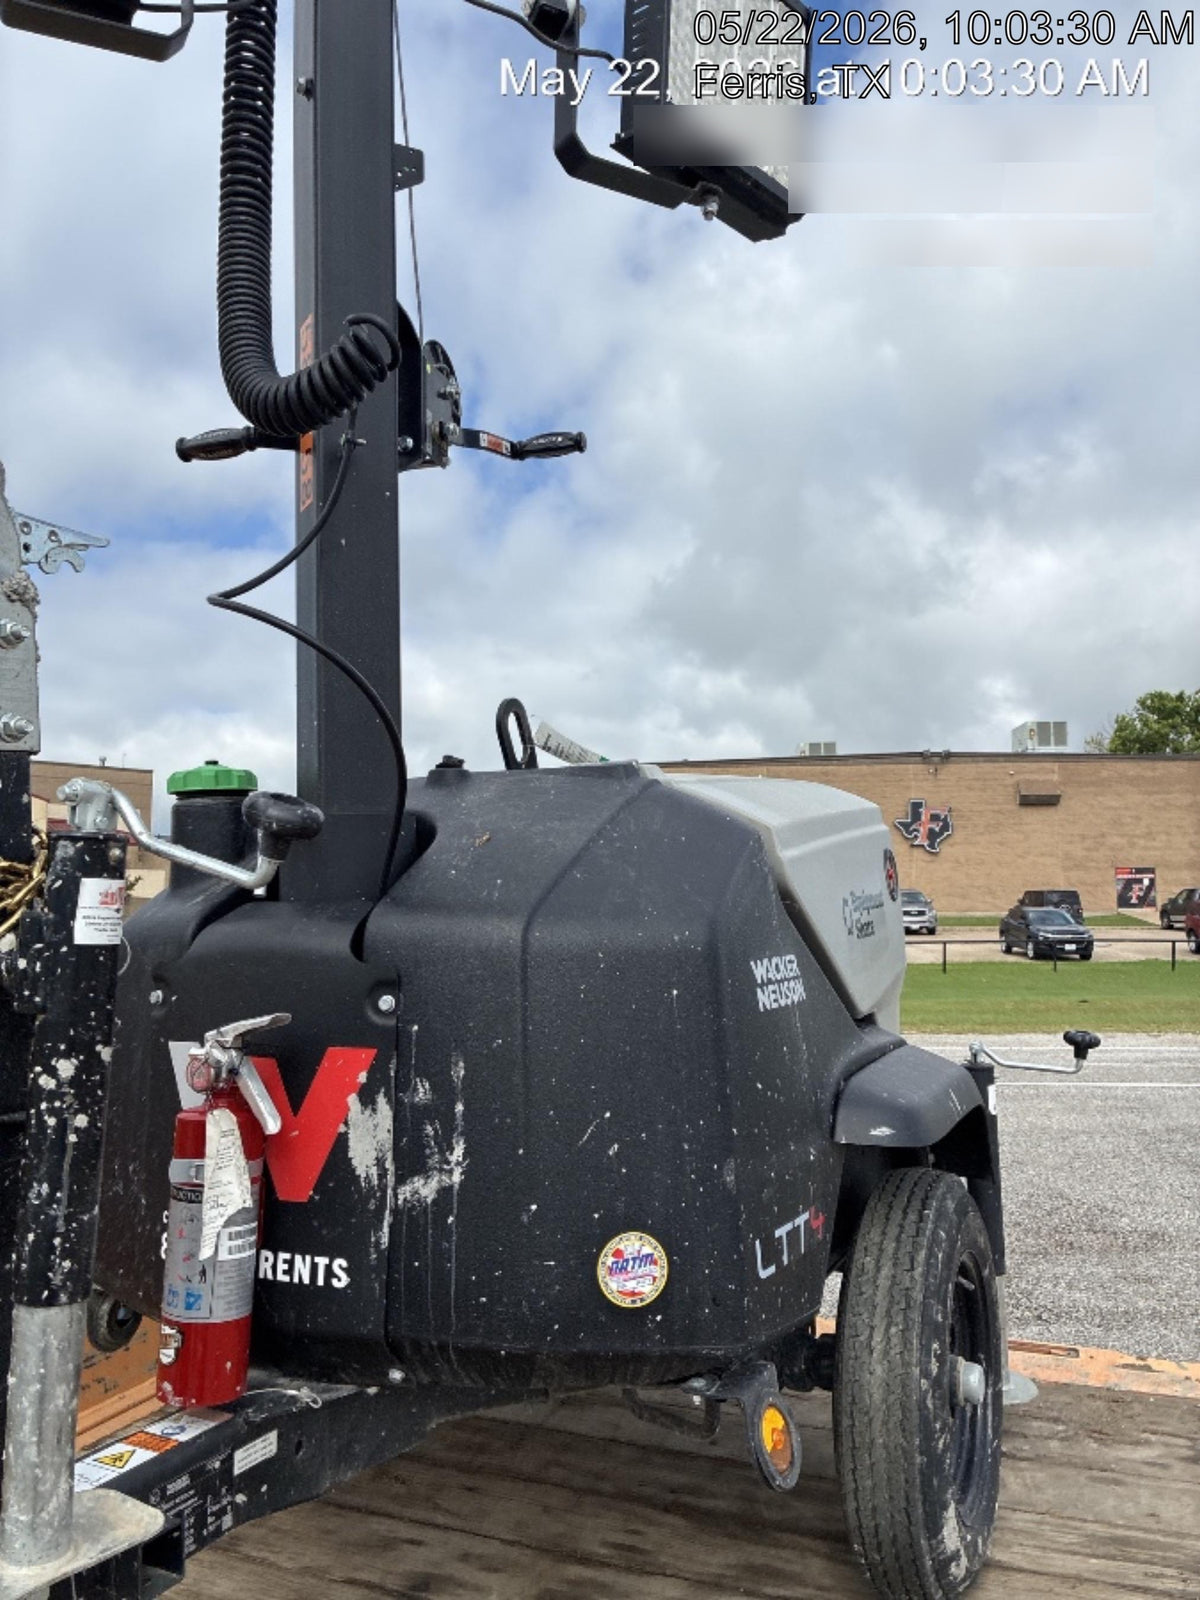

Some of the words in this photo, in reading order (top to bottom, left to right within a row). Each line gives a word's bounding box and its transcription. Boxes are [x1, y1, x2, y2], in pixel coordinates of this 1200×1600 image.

[750, 954, 801, 984] WACKER
[756, 977, 806, 1012] NEUSON
[258, 1250, 350, 1289] RENTS
